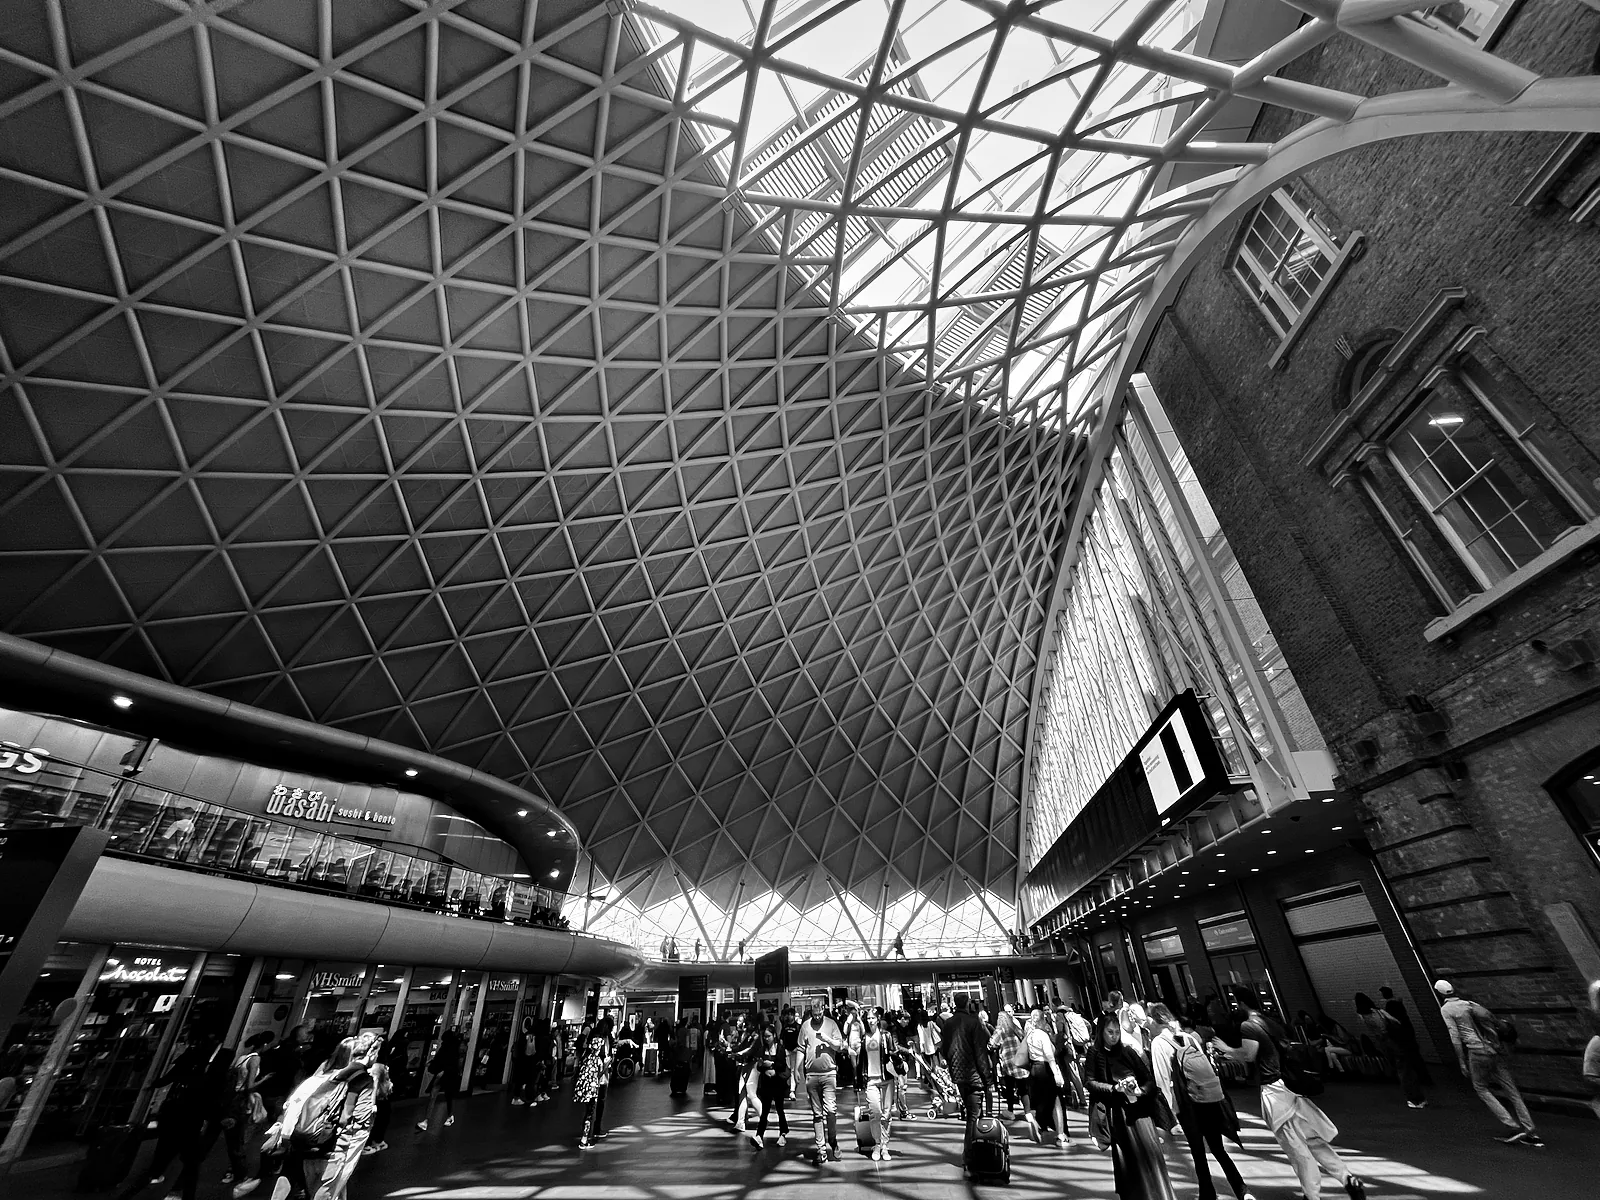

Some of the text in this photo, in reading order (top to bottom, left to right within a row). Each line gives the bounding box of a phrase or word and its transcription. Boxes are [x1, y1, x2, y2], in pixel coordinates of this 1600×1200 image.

[266, 793, 396, 825] wasabi sushi & bento
[134, 957, 161, 966] HOTEL
